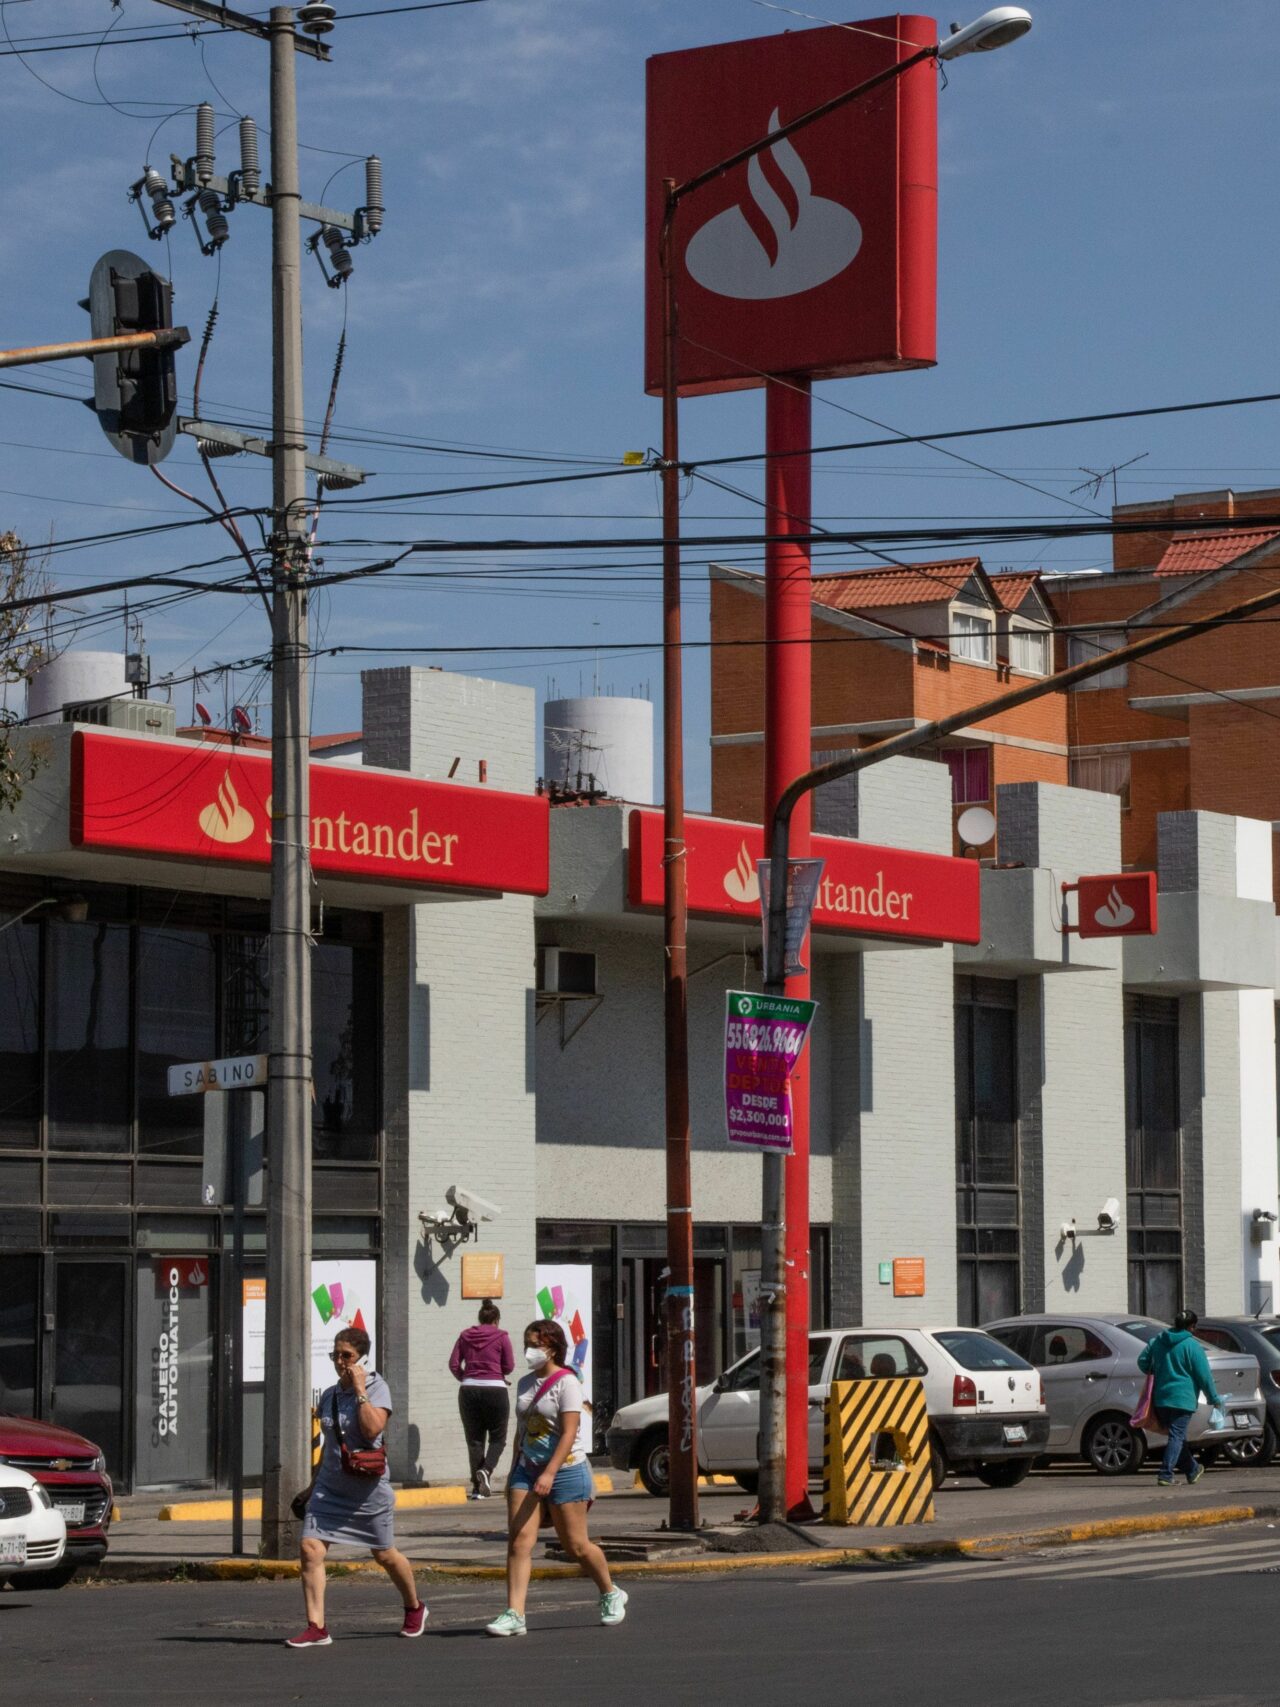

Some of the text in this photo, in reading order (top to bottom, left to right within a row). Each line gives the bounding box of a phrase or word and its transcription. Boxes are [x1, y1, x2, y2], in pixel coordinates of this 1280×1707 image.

[266, 793, 459, 866] ntander
[814, 870, 914, 920] tander
[756, 1001, 800, 1014] URBANIA
[183, 1063, 254, 1087] SABINO
[742, 1093, 778, 1110] DESDE
[168, 1267, 180, 1436] AUTOMATICO
[158, 1332, 169, 1437] CAJERO
